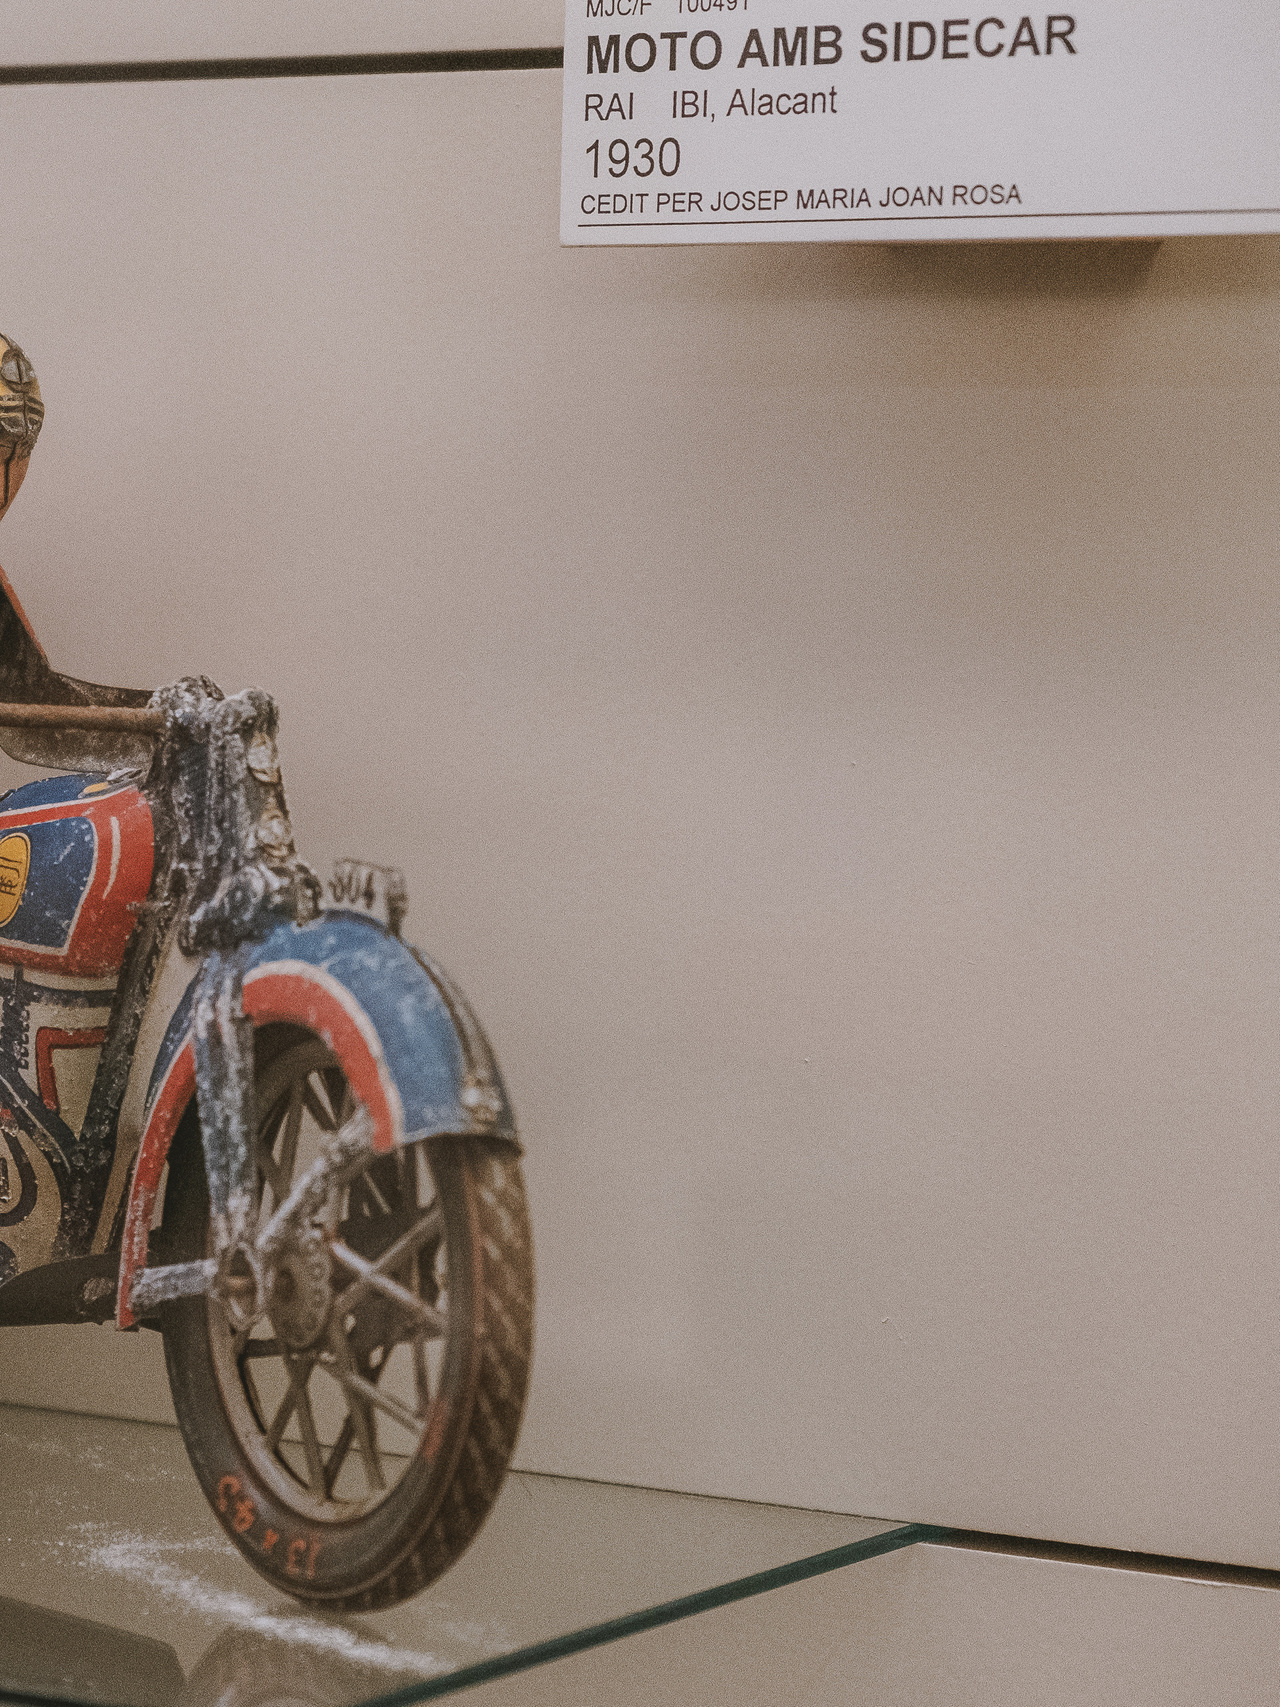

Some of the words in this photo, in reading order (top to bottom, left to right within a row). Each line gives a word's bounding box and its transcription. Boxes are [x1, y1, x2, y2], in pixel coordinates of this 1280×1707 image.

[586, 0, 652, 17] MJC/F
[586, 30, 723, 75] MOTO
[736, 25, 843, 69] AMB
[860, 15, 1077, 64] SIDECAR
[584, 92, 634, 122] RAI
[672, 90, 716, 123] IBI,
[726, 86, 838, 117] Alacant
[585, 137, 682, 179] 1930
[580, 193, 650, 215] CEDIT
[656, 191, 703, 213] PER
[710, 189, 789, 213] JOSEP
[796, 187, 872, 210] MARIA
[878, 185, 945, 208] JOAN
[952, 184, 1022, 206] ROSA
